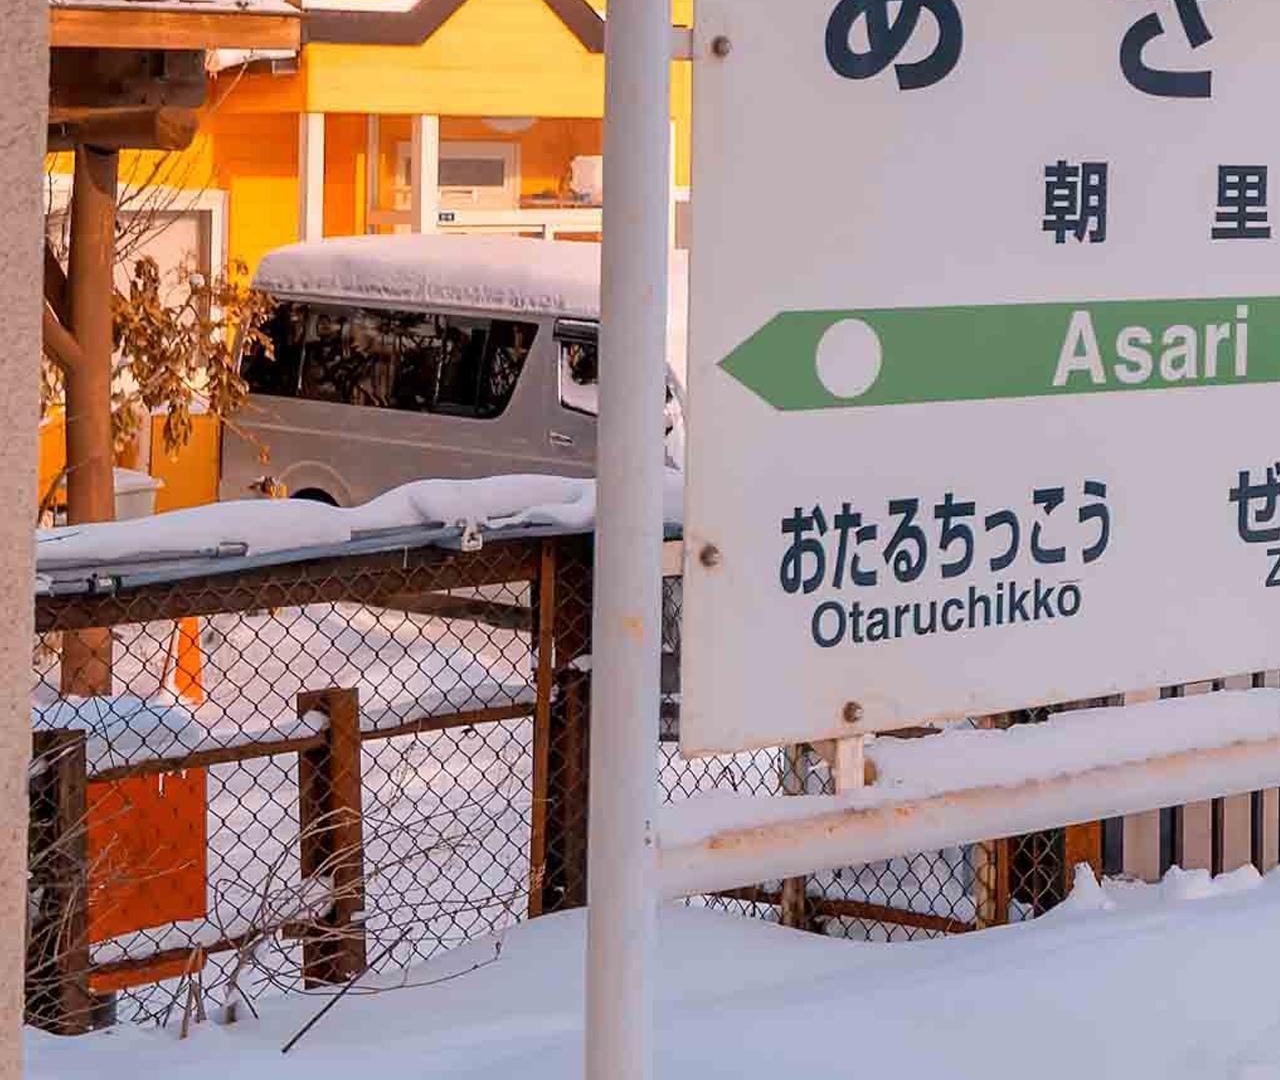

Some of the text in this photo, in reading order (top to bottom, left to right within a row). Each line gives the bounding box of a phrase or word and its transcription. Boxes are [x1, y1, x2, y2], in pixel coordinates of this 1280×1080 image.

[1041, 159, 1272, 245] 朝里
[1052, 304, 1249, 387] Asari
[779, 480, 1110, 595] おたるちっこう
